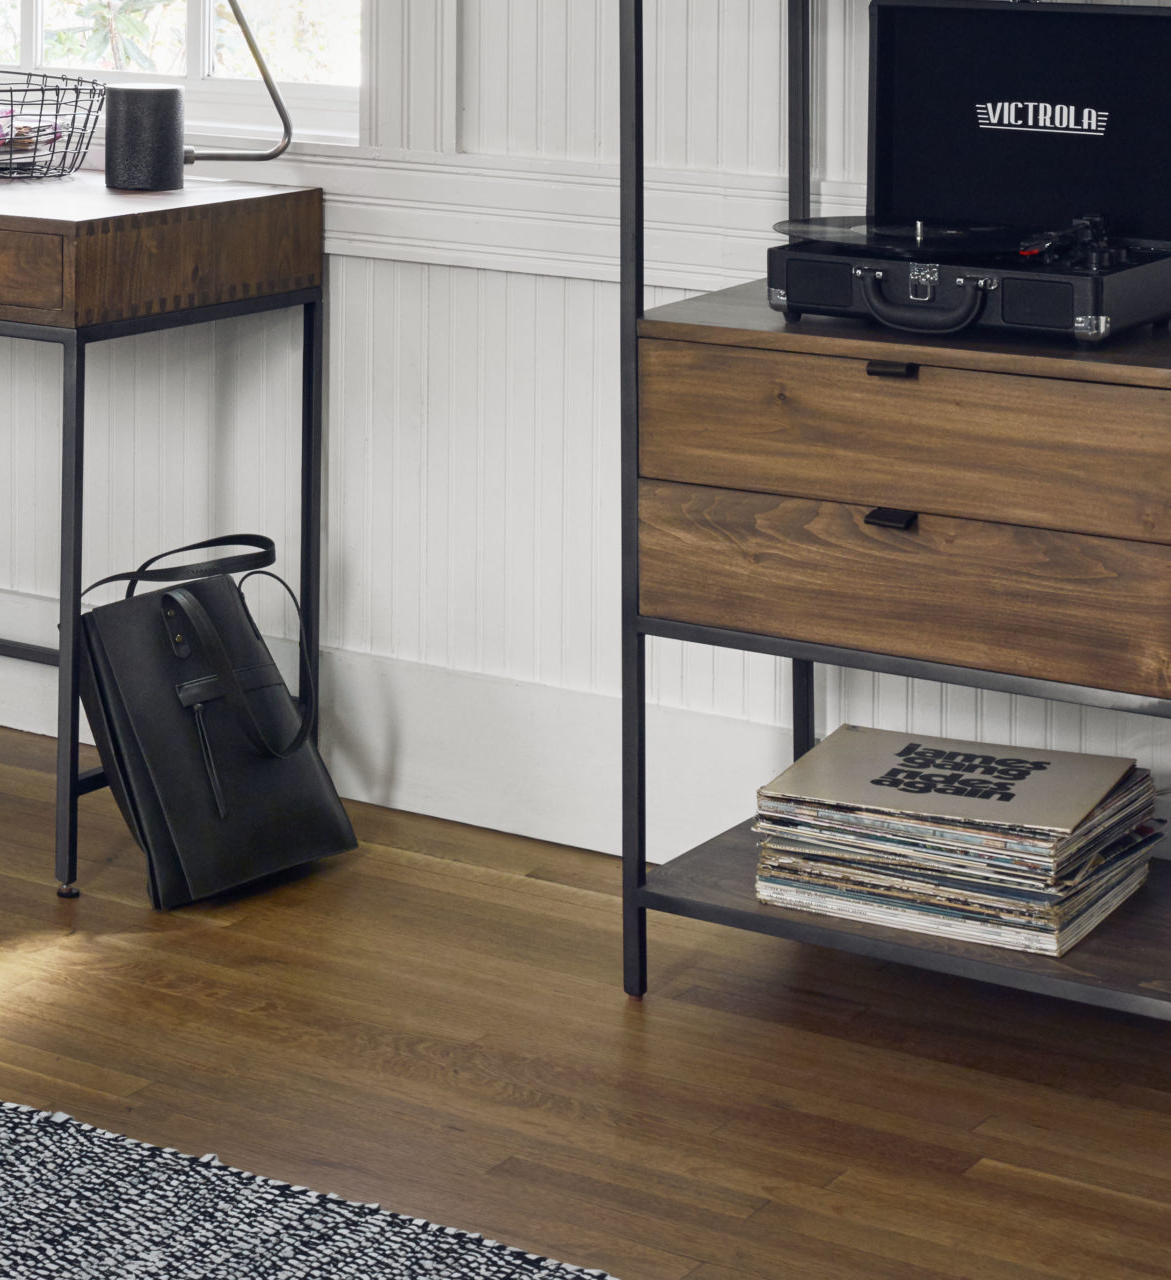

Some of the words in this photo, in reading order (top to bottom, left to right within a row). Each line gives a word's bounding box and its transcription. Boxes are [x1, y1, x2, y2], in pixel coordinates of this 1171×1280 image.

[986, 102, 1097, 130] VICTROLA
[897, 756, 1031, 781] gang
[870, 778, 1016, 802] again
